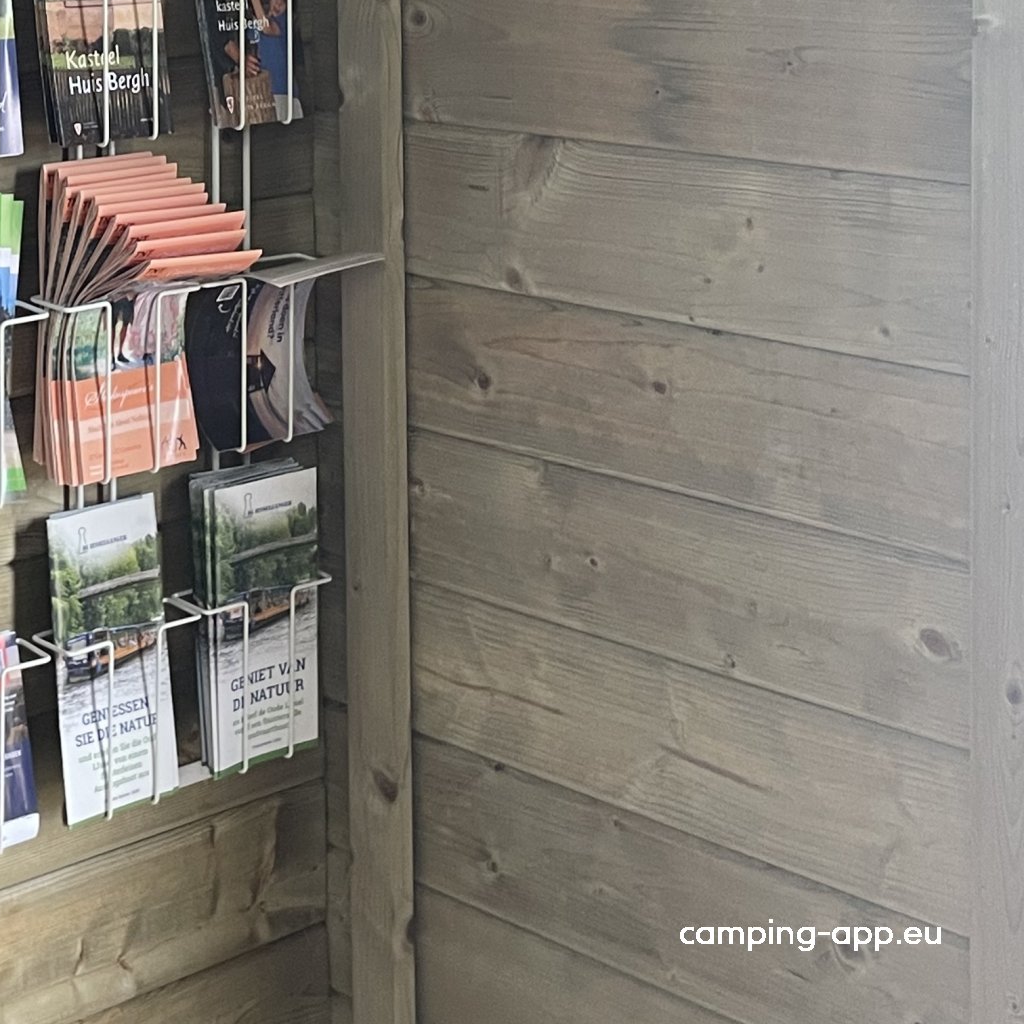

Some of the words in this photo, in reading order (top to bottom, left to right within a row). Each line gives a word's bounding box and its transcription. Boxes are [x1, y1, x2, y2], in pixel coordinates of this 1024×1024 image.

[217, 19, 239, 32] Huis
[68, 72, 103, 96] Huis
[107, 67, 150, 94] Bergh
[75, 730, 95, 748] SIE
